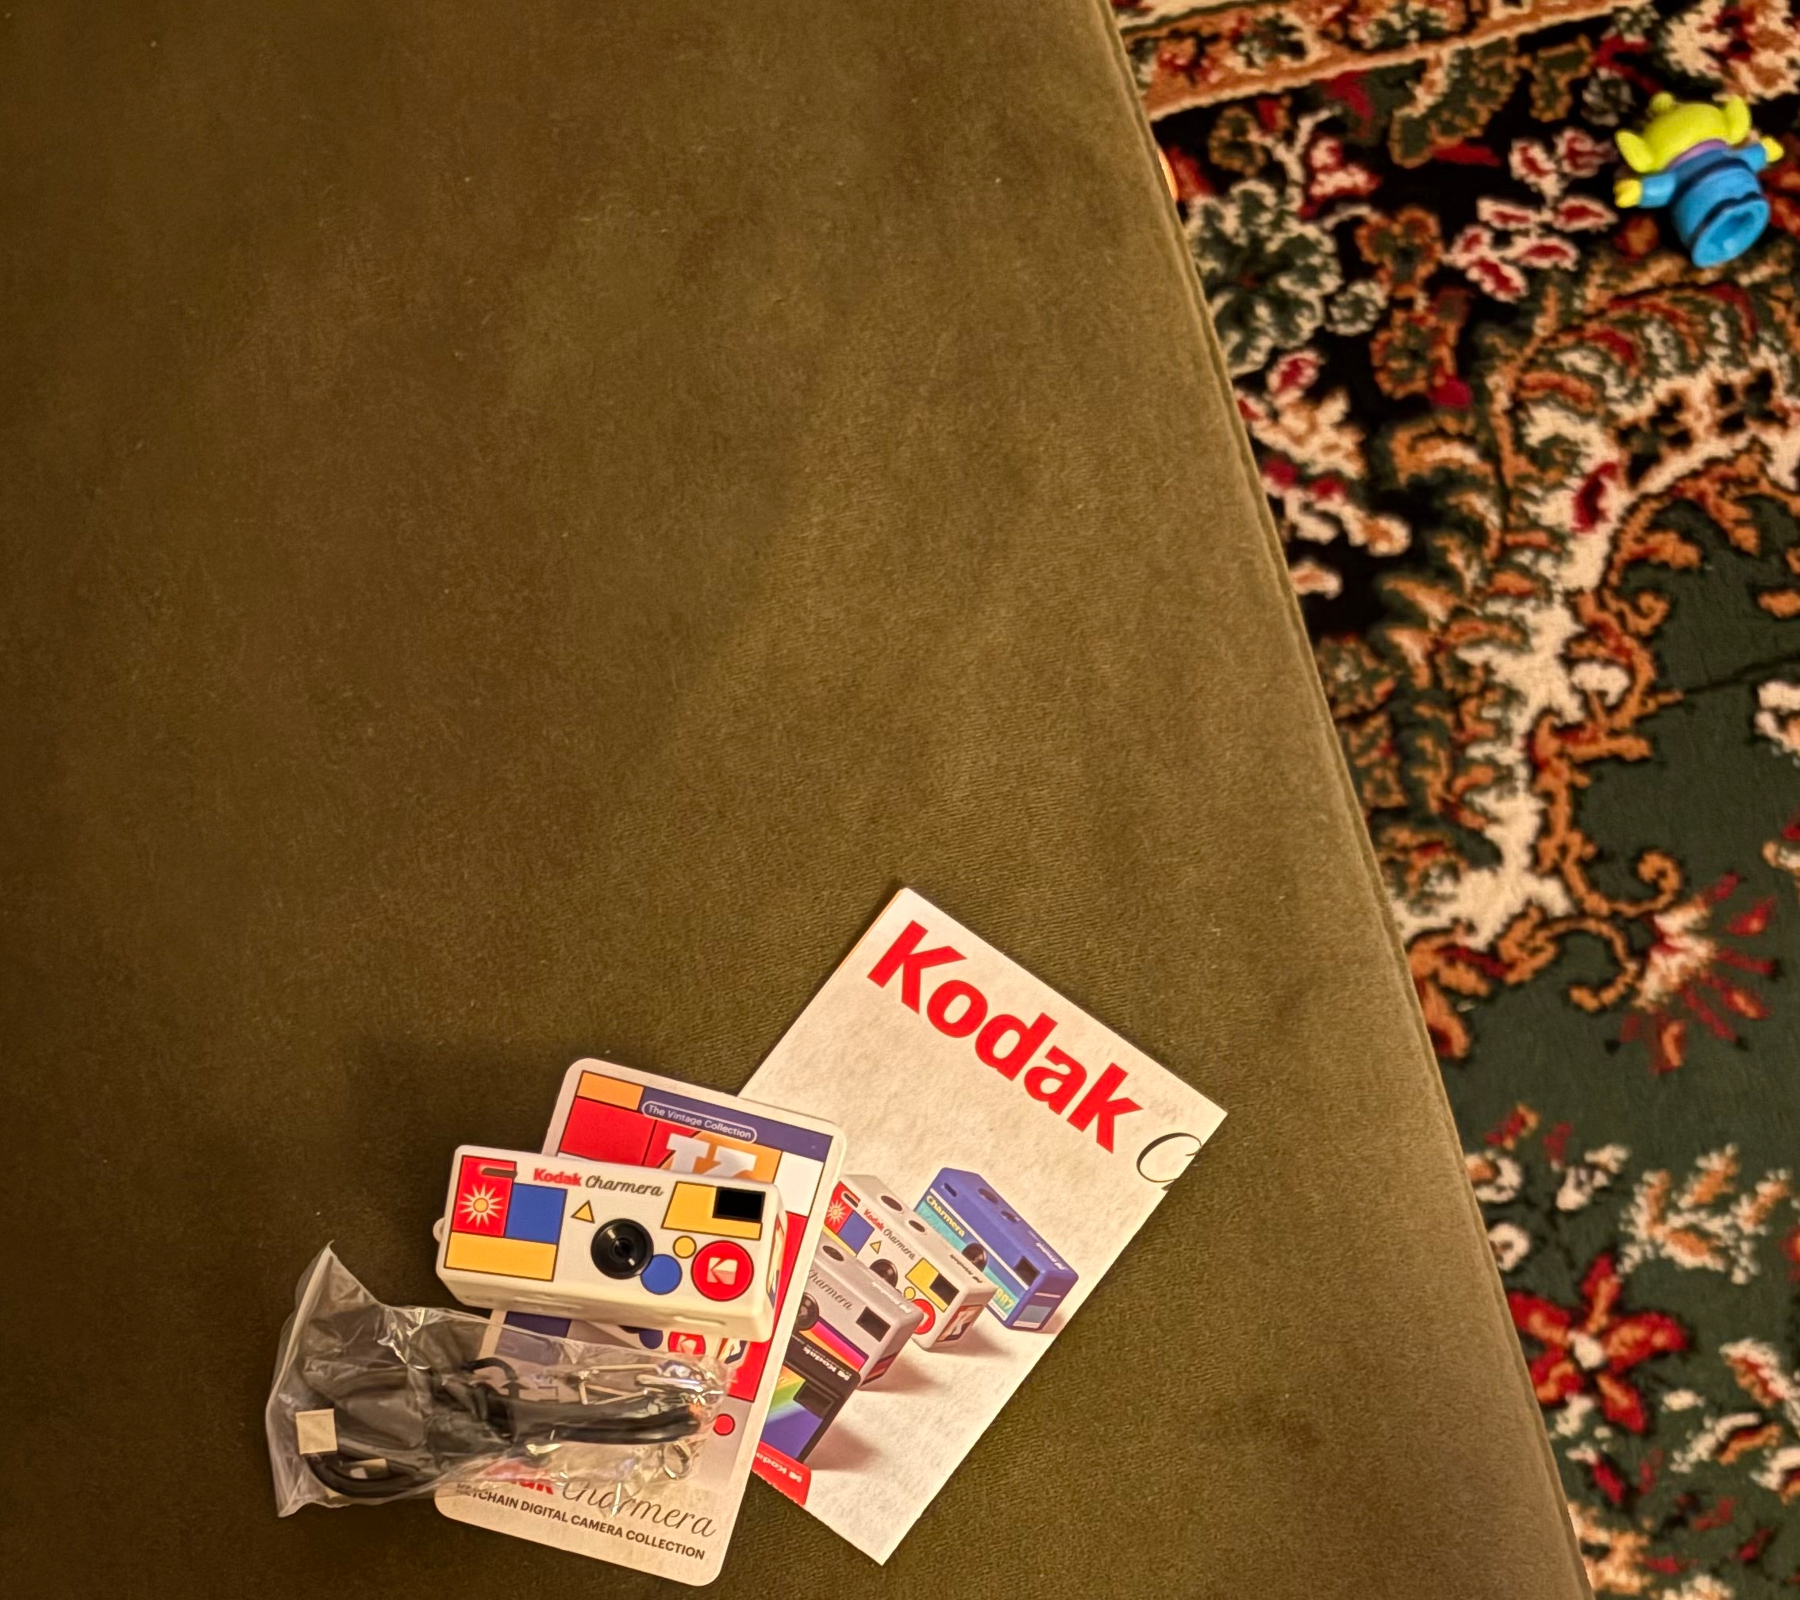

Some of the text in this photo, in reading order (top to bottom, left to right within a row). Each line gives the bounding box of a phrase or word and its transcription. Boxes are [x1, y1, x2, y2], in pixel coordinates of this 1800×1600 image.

[867, 920, 1202, 1192] Kodak C
[647, 1103, 752, 1140] The Vintage Collection
[533, 1167, 665, 1197] Kodak Charmera
[862, 1207, 885, 1232] Kodak
[883, 1227, 915, 1262] Charmera
[926, 1194, 966, 1239] Charmera
[521, 1501, 568, 1523] DIGITAL
[570, 1515, 623, 1538] CAMERA
[626, 1530, 706, 1561] COLLECTION
